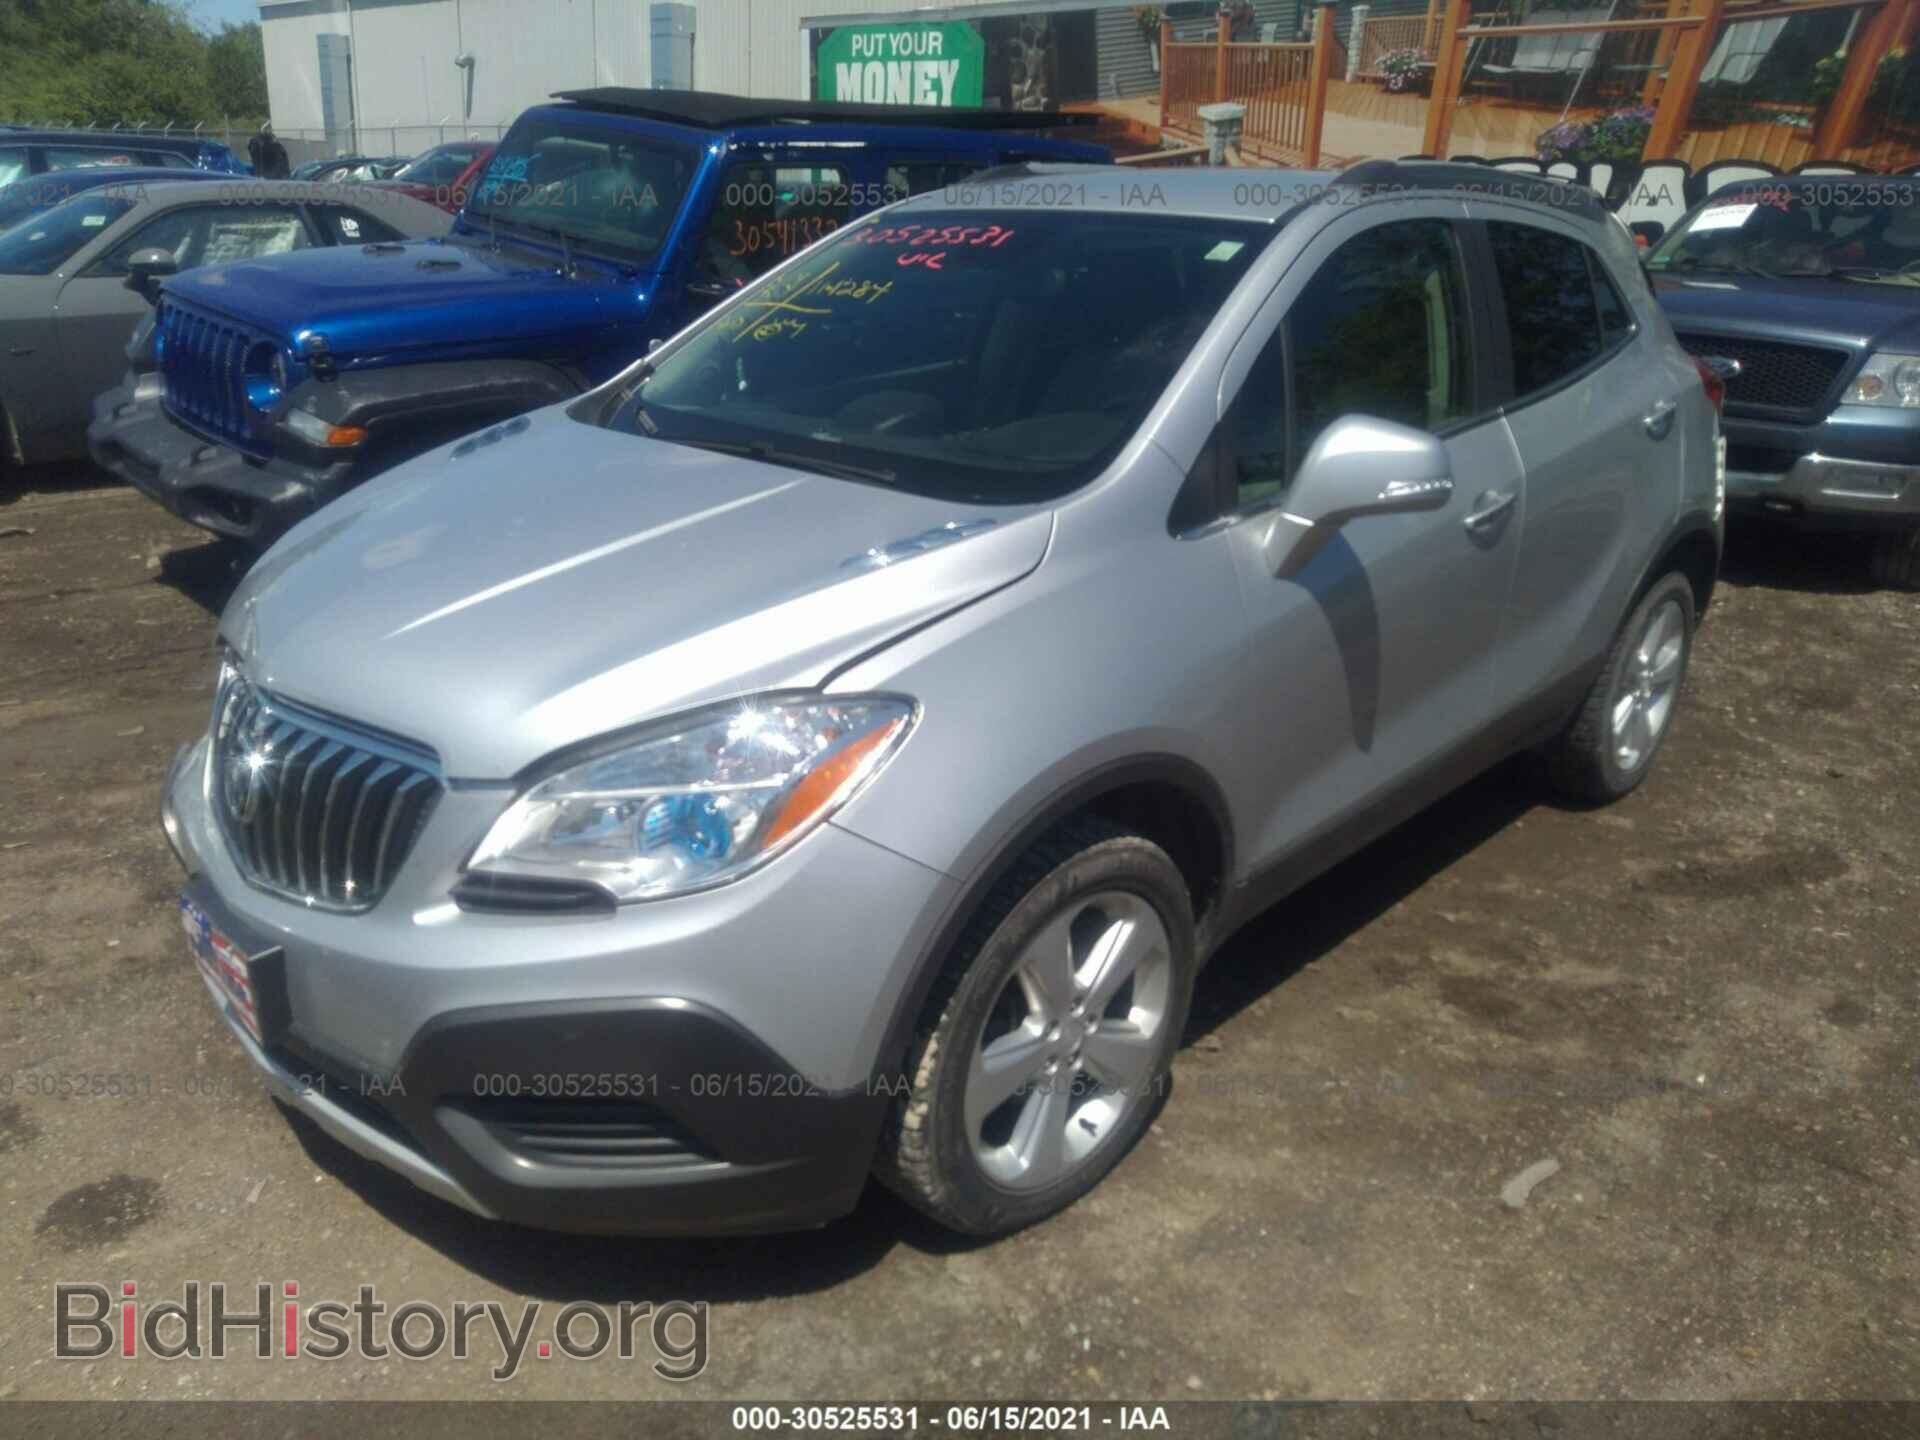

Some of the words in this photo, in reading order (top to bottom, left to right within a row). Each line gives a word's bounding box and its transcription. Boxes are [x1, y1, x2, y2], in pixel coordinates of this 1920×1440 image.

[851, 33, 887, 56] PUT
[889, 31, 943, 55] YOUR
[835, 58, 960, 106] MONEY
